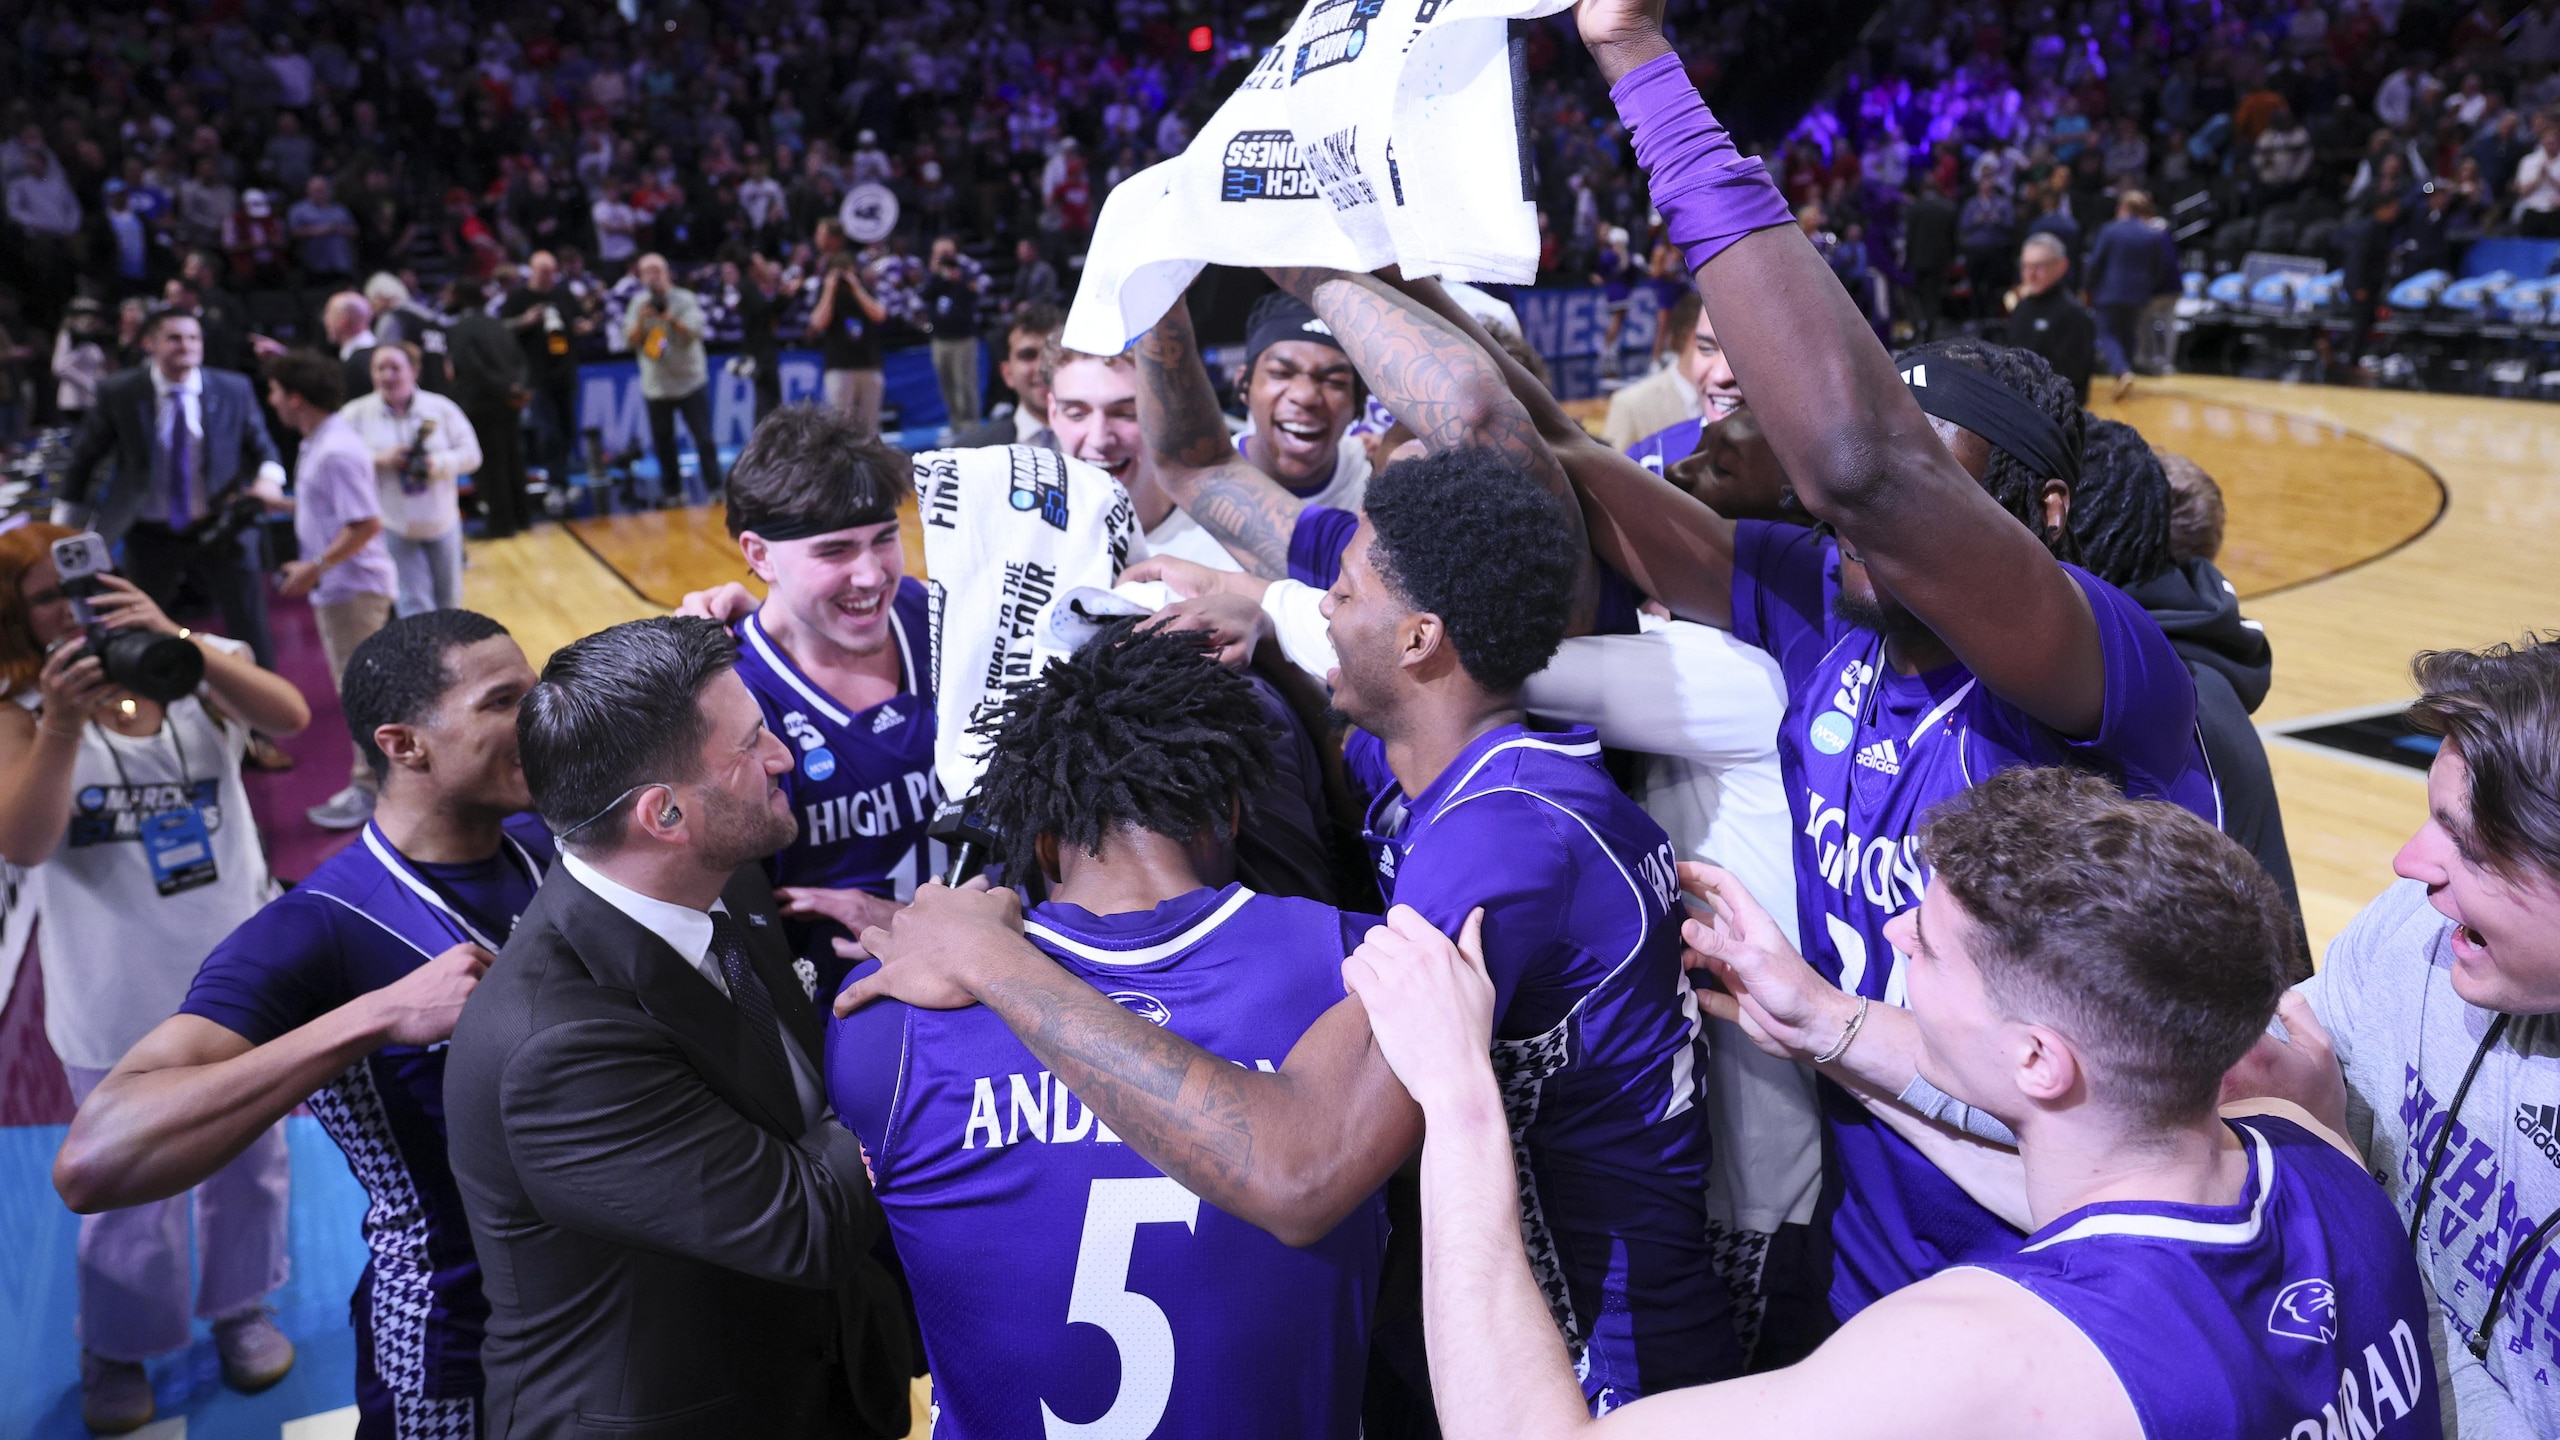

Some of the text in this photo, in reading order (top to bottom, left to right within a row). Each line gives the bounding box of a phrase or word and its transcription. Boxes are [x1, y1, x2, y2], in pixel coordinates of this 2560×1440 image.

[1265, 169, 1316, 196] RCH
[1003, 560, 1024, 596] THE
[999, 603, 1013, 629] TO
[985, 635, 1007, 690] ROAD
[1813, 724, 1847, 750] NCAA
[1856, 752, 1900, 776] adidas
[805, 782, 903, 847] HIGH
[1039, 1176, 1200, 1440] 5
